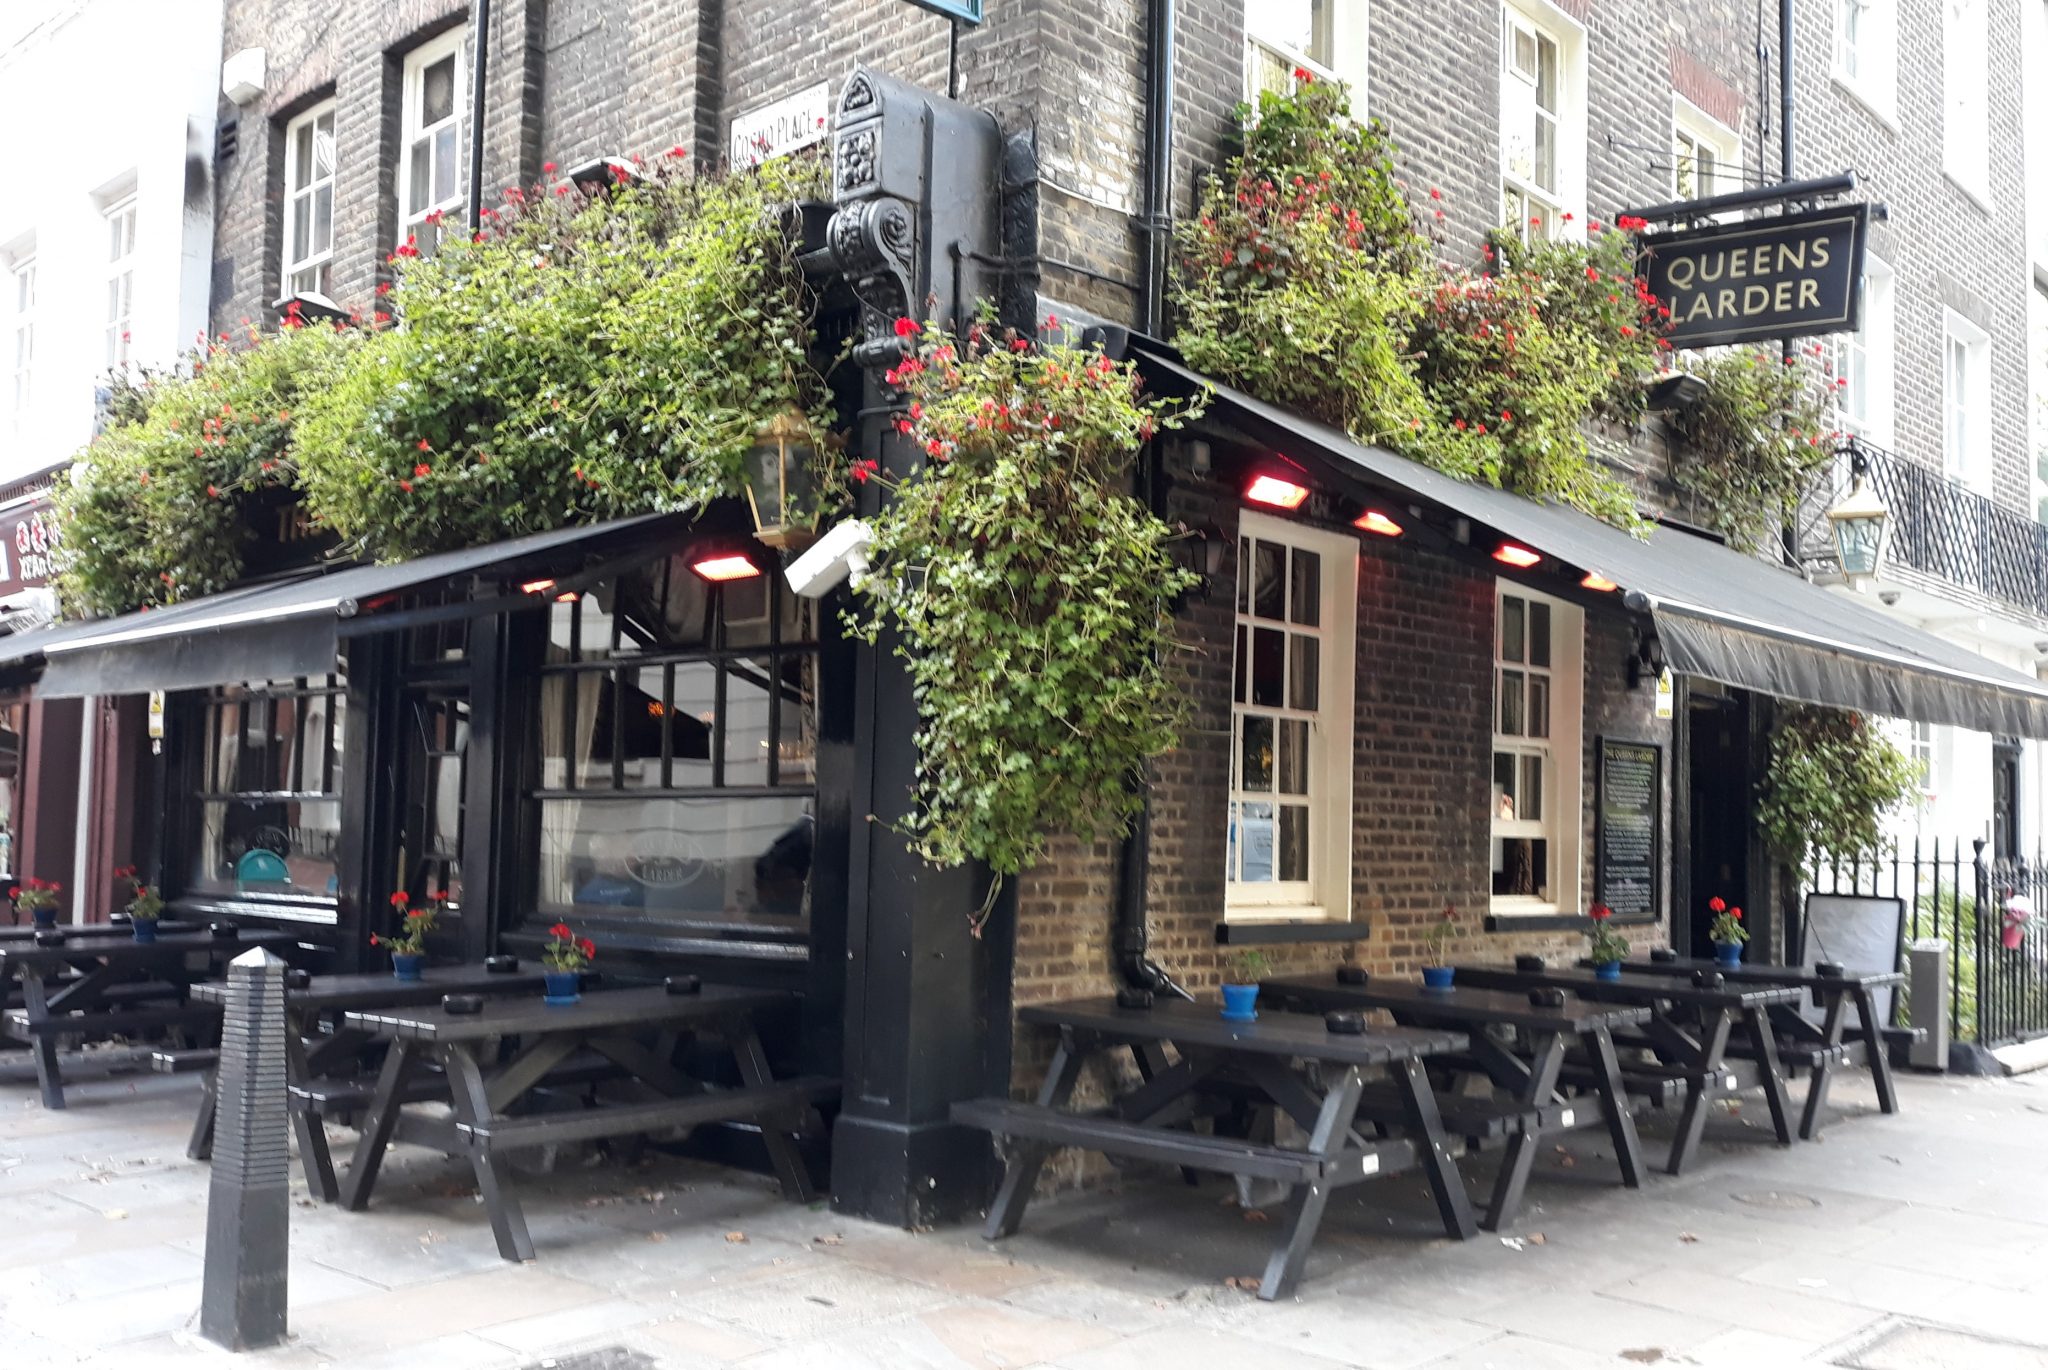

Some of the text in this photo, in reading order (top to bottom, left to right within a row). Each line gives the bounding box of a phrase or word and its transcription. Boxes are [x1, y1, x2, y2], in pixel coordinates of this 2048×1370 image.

[777, 109, 814, 146] PLACE
[1667, 237, 1830, 290] QUEENS
[1669, 278, 1821, 323] LARDER
